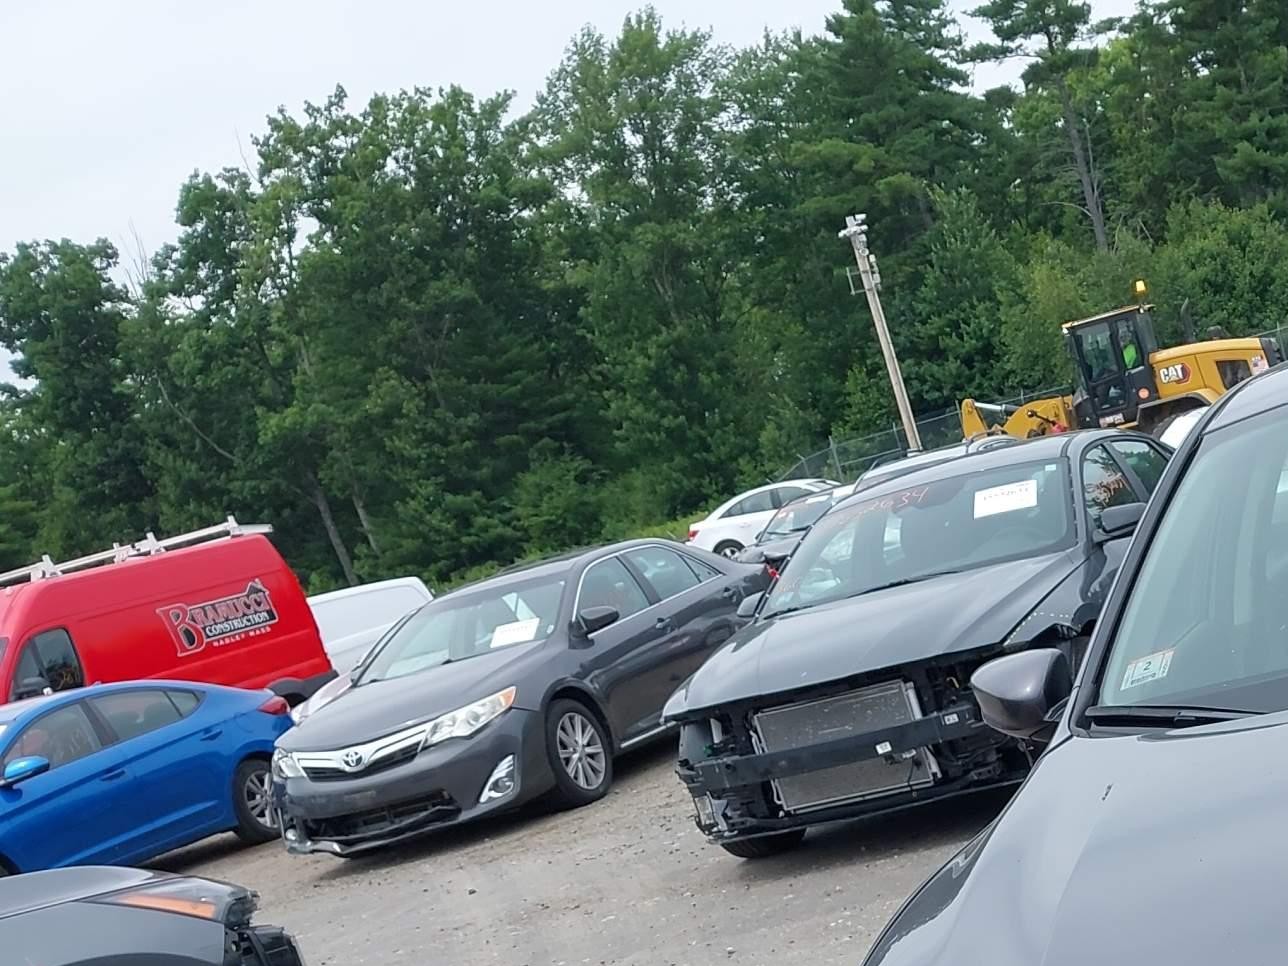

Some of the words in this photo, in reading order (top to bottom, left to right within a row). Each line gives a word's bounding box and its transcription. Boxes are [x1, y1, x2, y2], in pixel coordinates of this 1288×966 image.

[1160, 363, 1184, 384] CAT
[205, 612, 270, 637] CONSTRUCTION
[249, 625, 272, 637] MASS
[1143, 660, 1152, 671] 2
